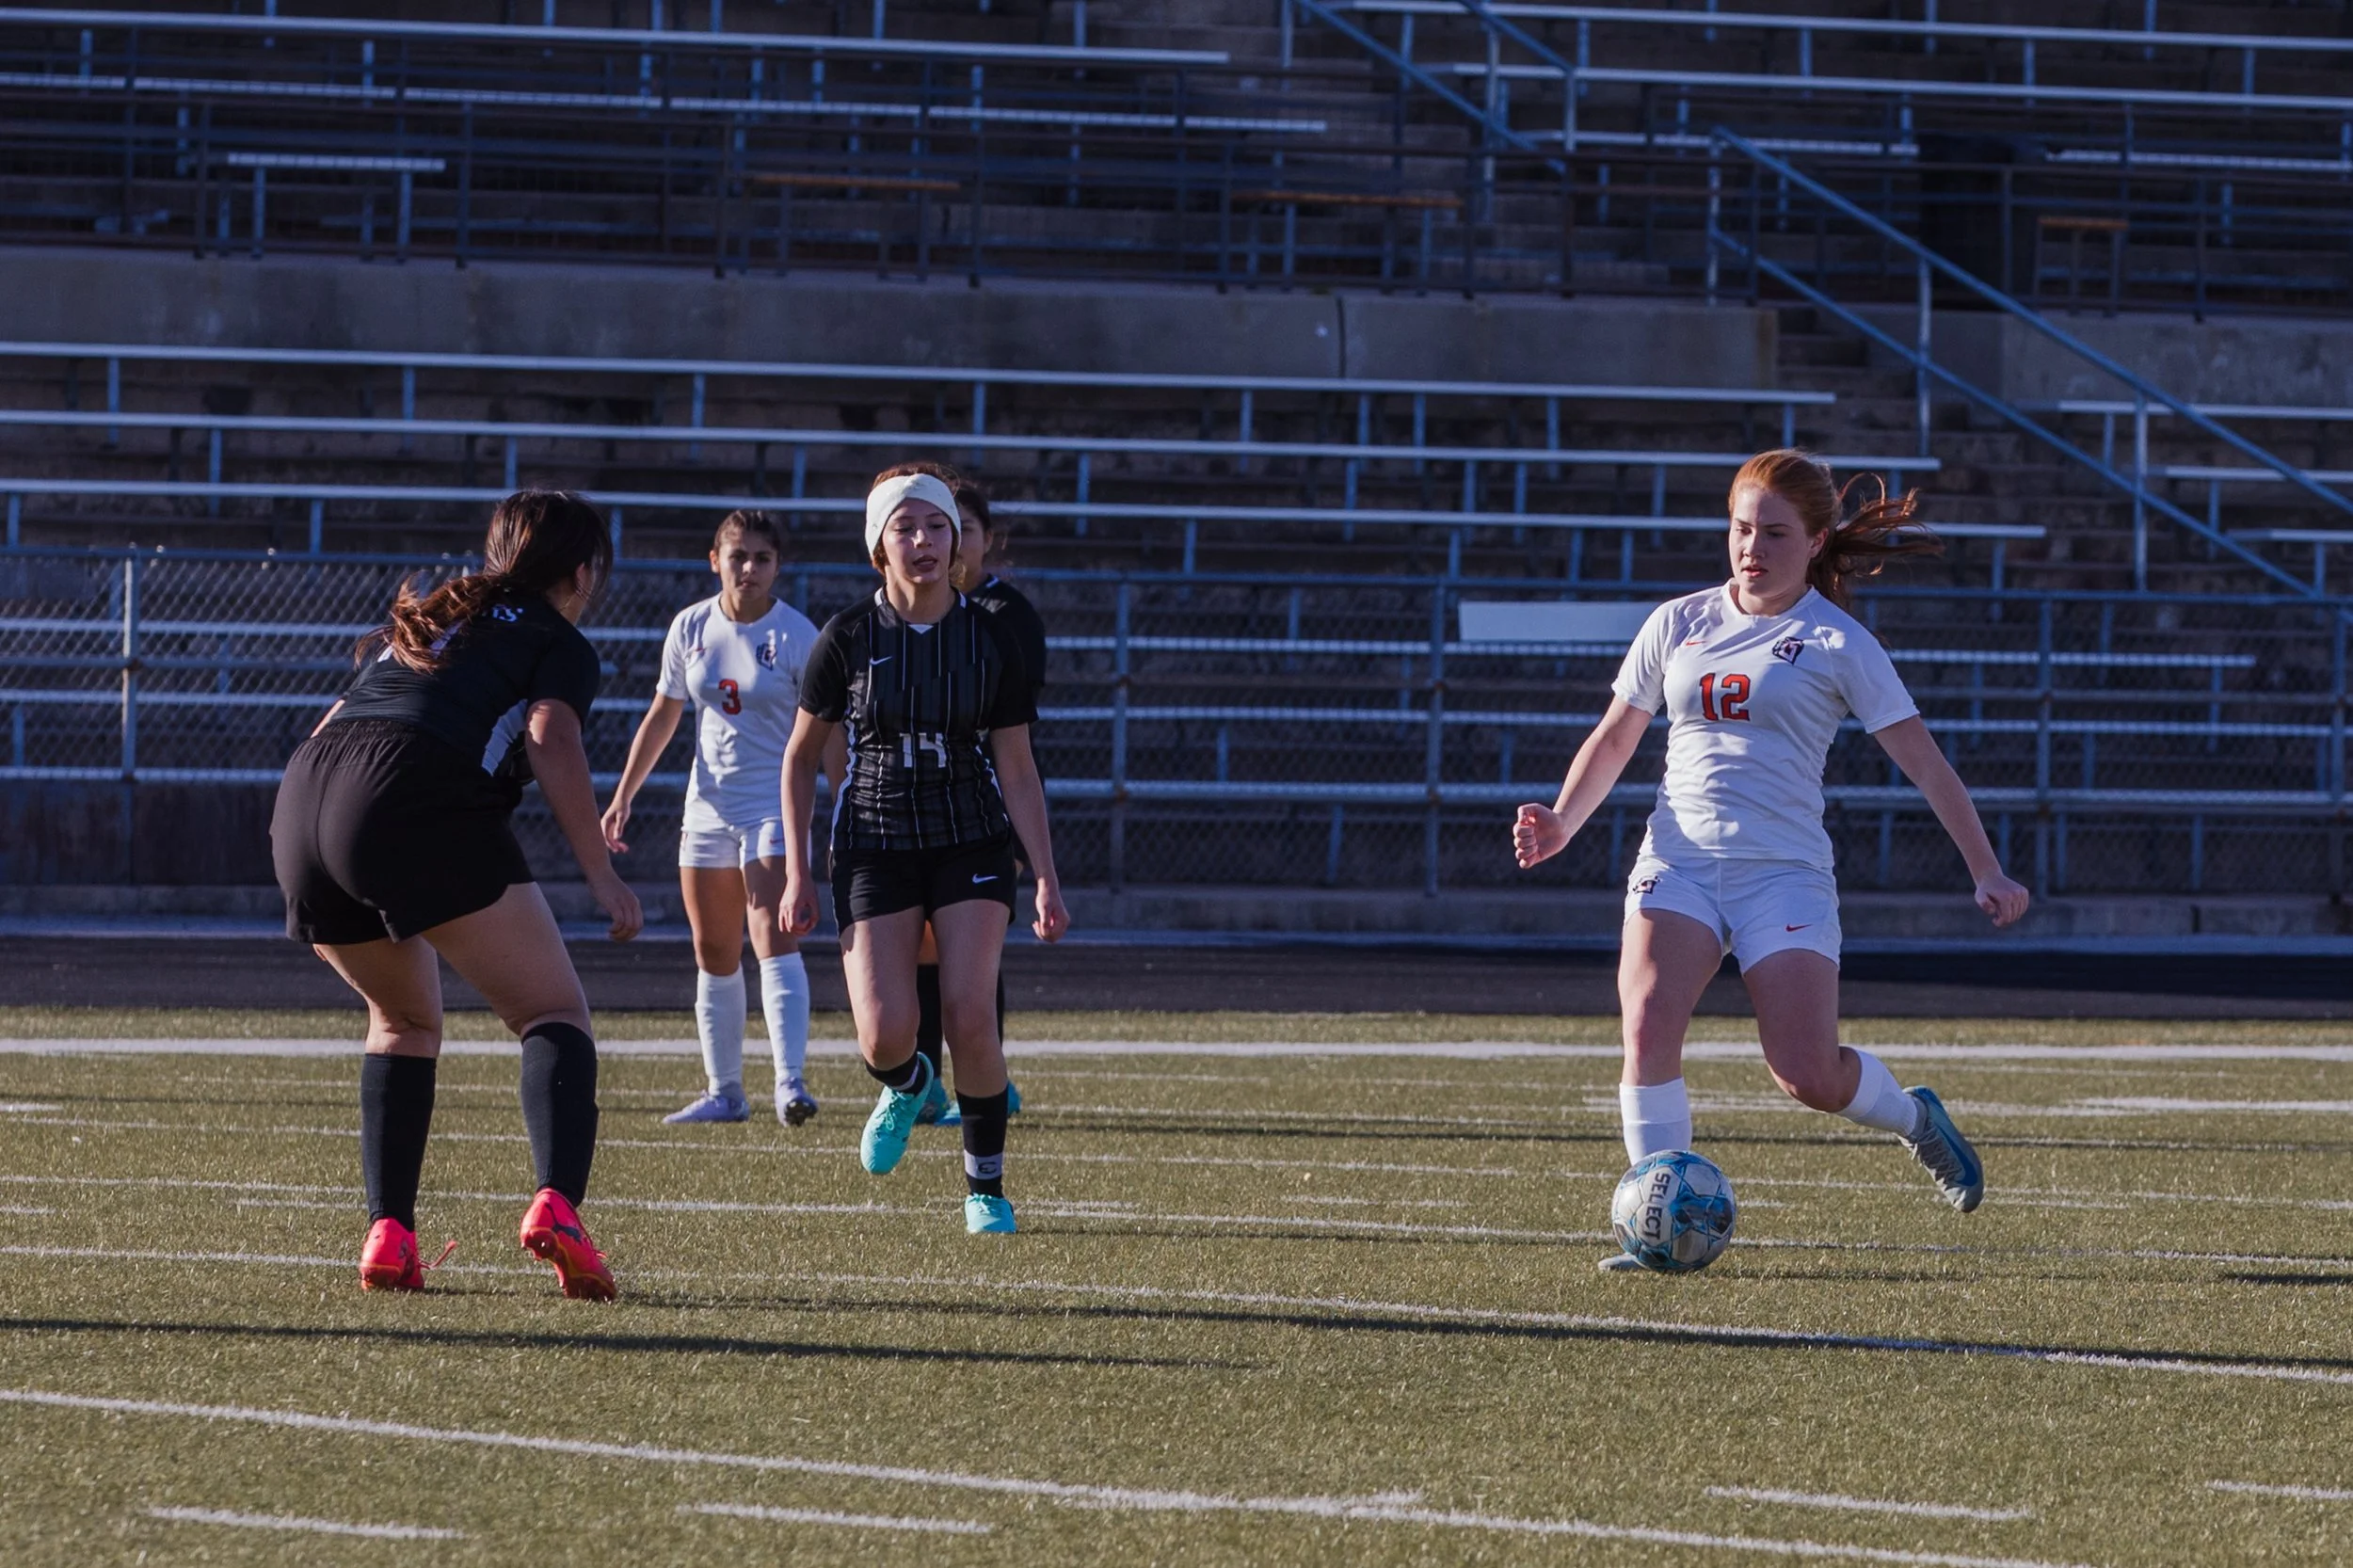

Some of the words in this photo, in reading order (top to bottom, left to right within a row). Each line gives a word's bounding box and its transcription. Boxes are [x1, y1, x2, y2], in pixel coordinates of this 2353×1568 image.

[718, 679, 743, 715] 3
[1699, 673, 1752, 721] 12
[899, 732, 947, 768] 14
[1644, 1173, 1672, 1240] SELECT
